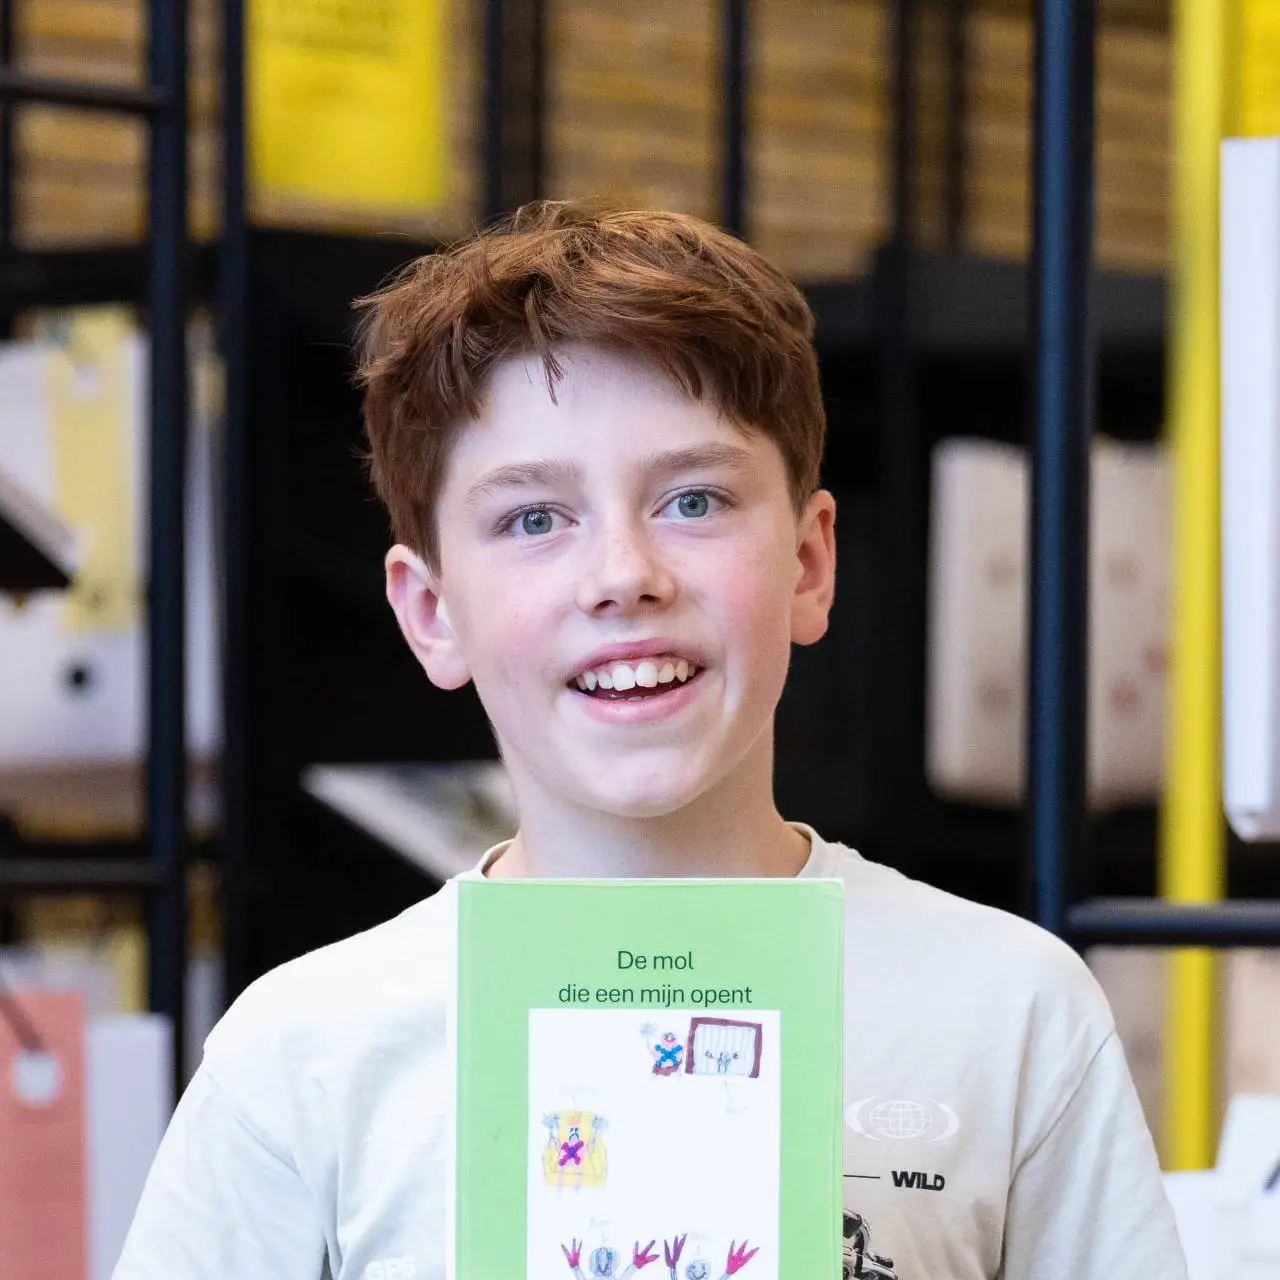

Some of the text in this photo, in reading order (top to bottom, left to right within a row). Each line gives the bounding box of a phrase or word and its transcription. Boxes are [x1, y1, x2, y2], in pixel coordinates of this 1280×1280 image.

[617, 950, 695, 970] De mol
[558, 983, 753, 1008] die een mijn opent
[891, 1170, 946, 1192] WILD
